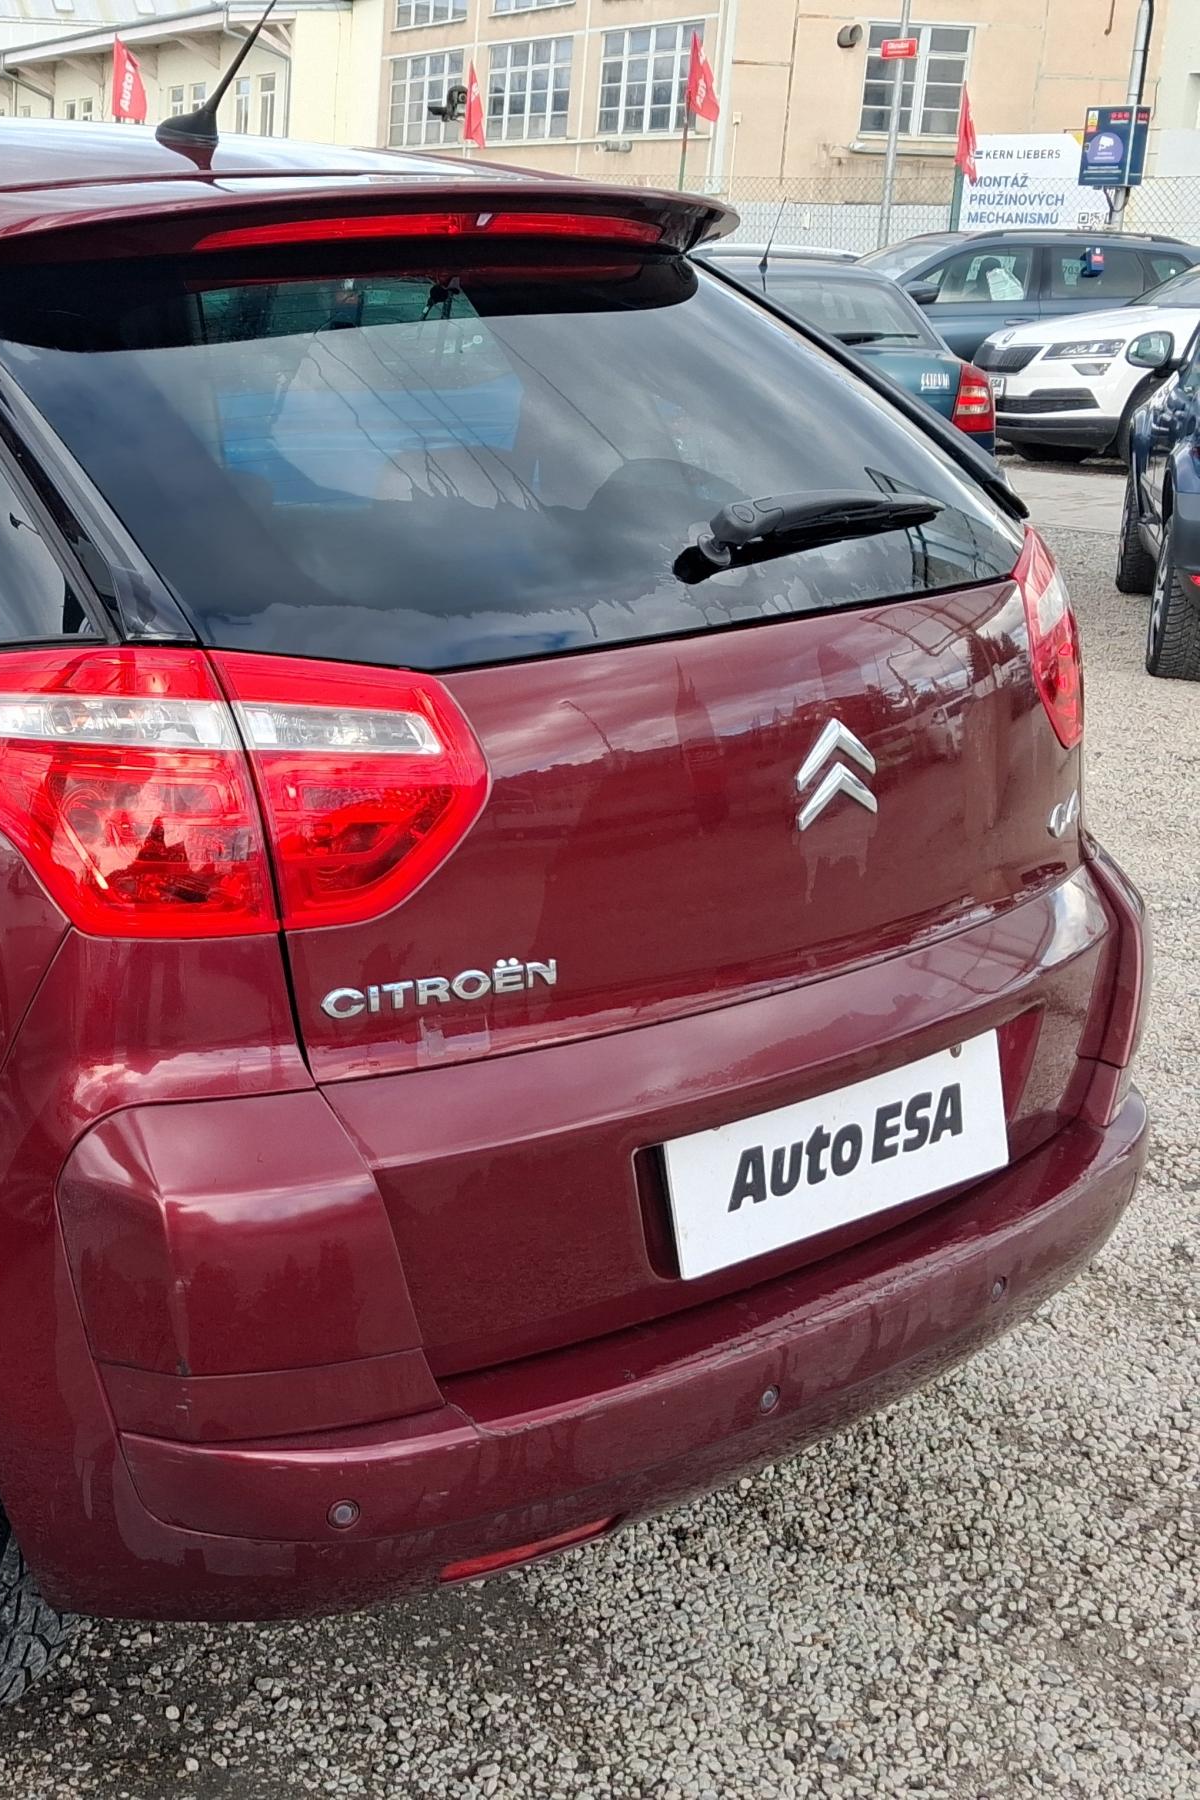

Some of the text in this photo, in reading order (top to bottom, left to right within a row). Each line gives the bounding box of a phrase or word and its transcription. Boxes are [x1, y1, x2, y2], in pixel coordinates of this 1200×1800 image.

[120, 72, 134, 112] Auto
[985, 149, 1061, 160] KERN LIEBERS
[969, 191, 1065, 206] PRUŽINOVÝCH
[320, 957, 557, 1019] CITROËN
[727, 1082, 963, 1213] Auto ESA
